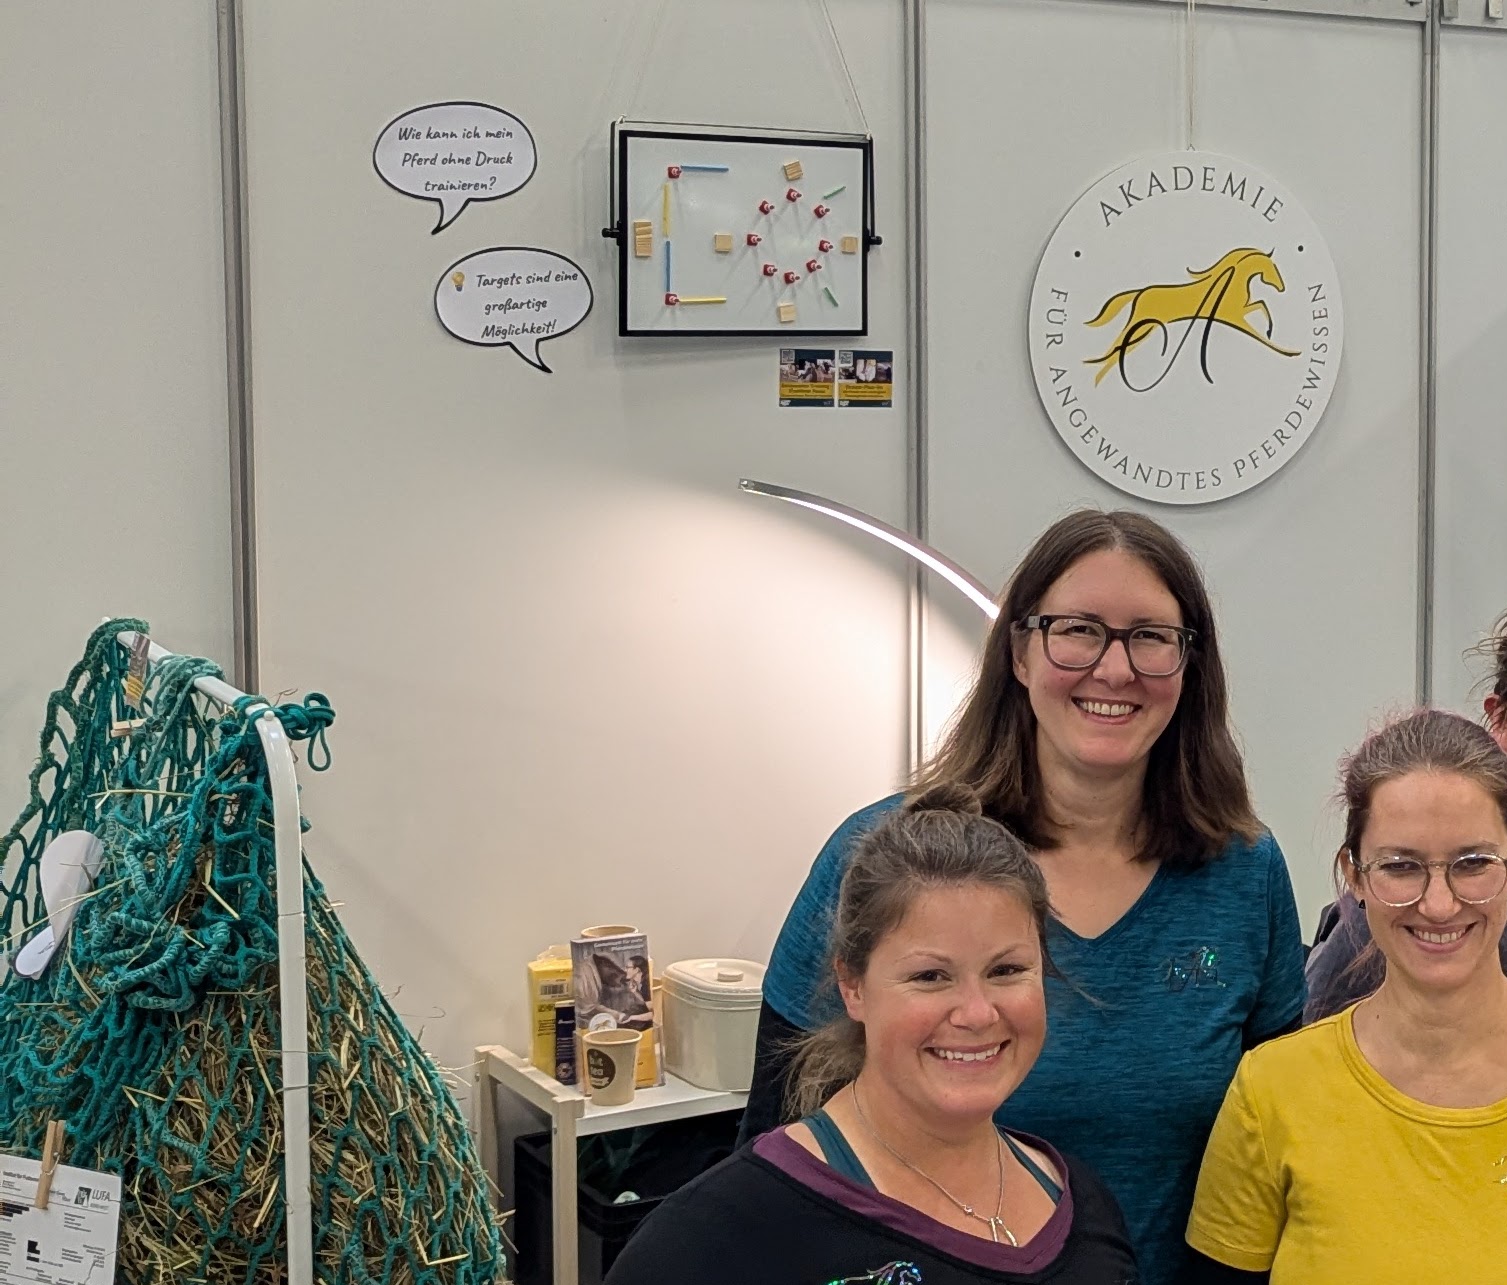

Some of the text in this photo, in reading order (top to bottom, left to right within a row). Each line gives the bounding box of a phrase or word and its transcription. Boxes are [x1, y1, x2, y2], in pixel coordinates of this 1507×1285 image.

[399, 127, 513, 140] Wie kann ich mein
[402, 151, 513, 167] Pferd ohne Druck
[425, 177, 496, 191] trainieren?
[1099, 166, 1284, 227] AKADEMIE
[476, 271, 578, 288] Targets sind eine
[485, 299, 547, 315] großartige
[481, 320, 556, 339] Möglichkeit!
[1046, 284, 1328, 490] FÜR ANGEWANDTES PFERDEWISSEN
